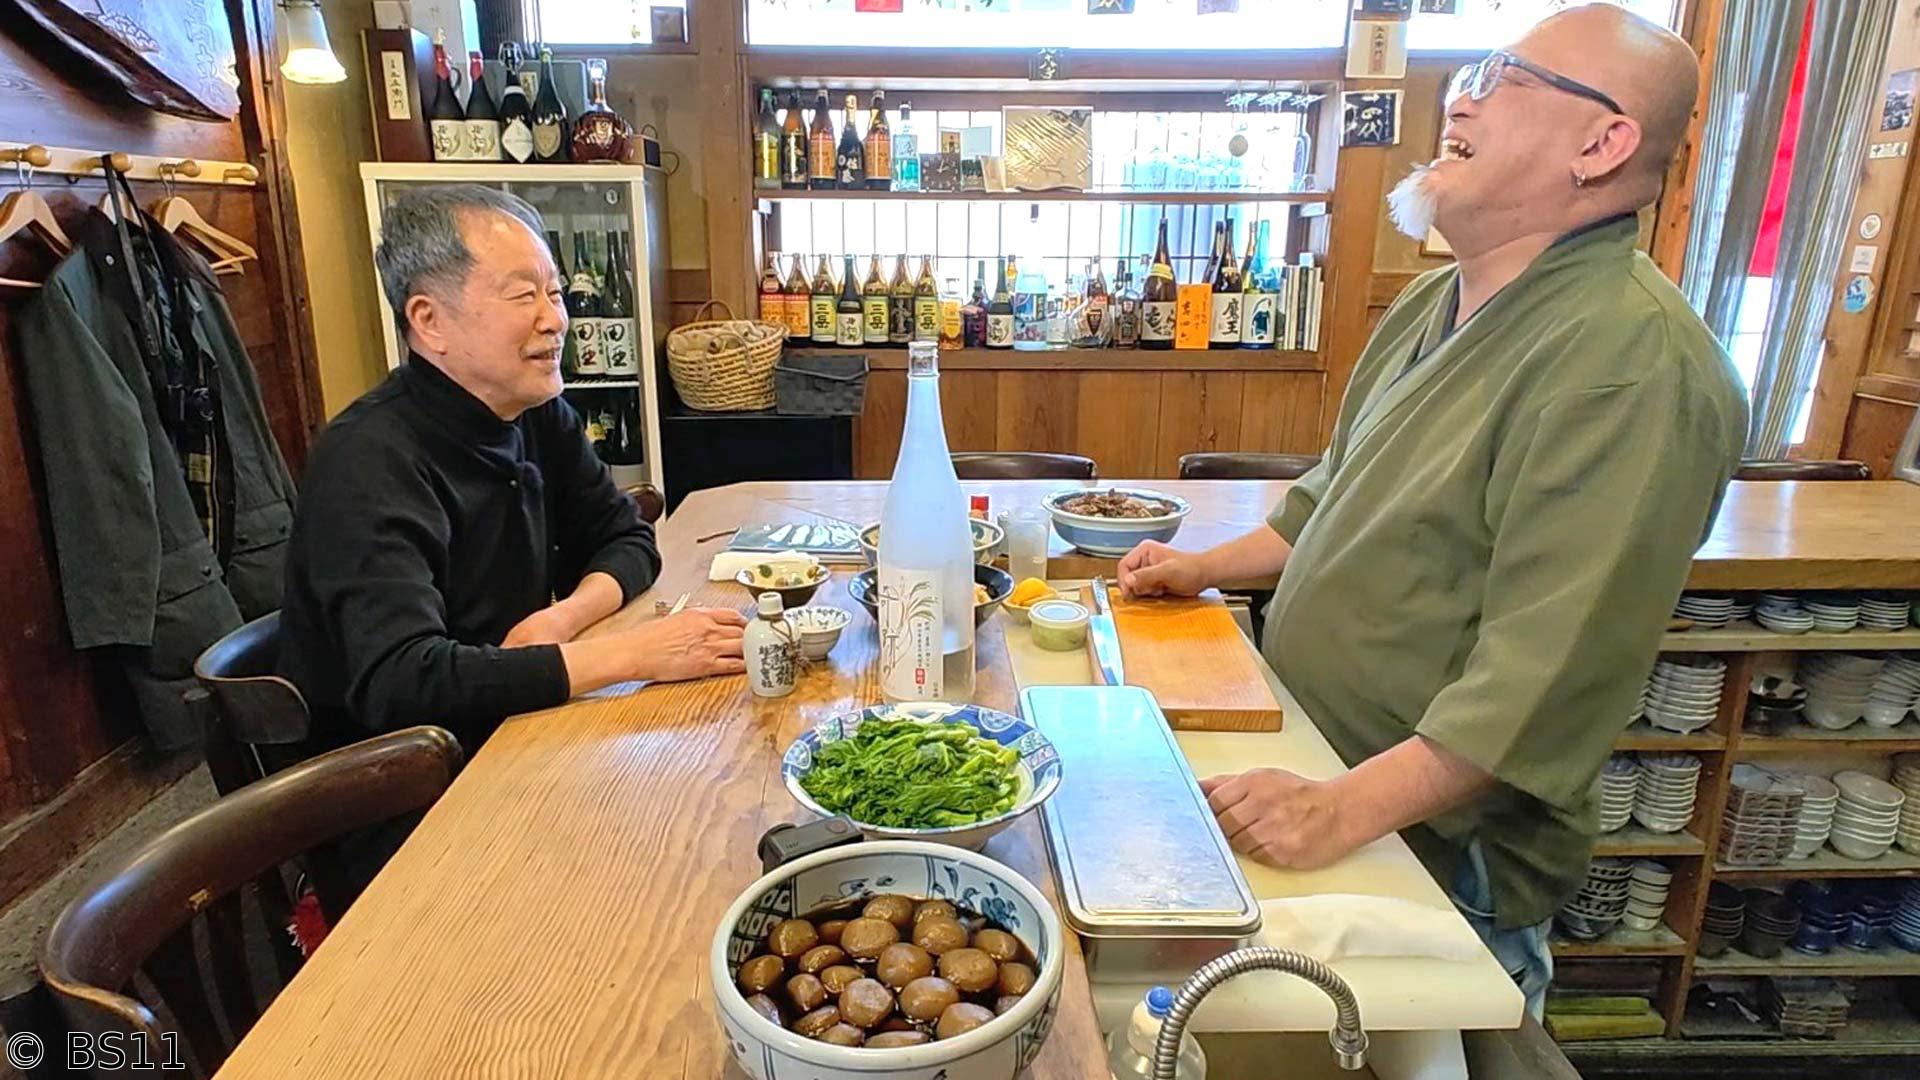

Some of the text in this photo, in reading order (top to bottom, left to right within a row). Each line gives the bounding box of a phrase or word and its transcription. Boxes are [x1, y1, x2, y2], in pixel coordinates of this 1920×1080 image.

[815, 303, 831, 329] 三岳
[869, 303, 886, 330] 三岳
[920, 304, 936, 330] 三岳
[1222, 298, 1240, 336] 魔王
[603, 322, 628, 369] 田酒
